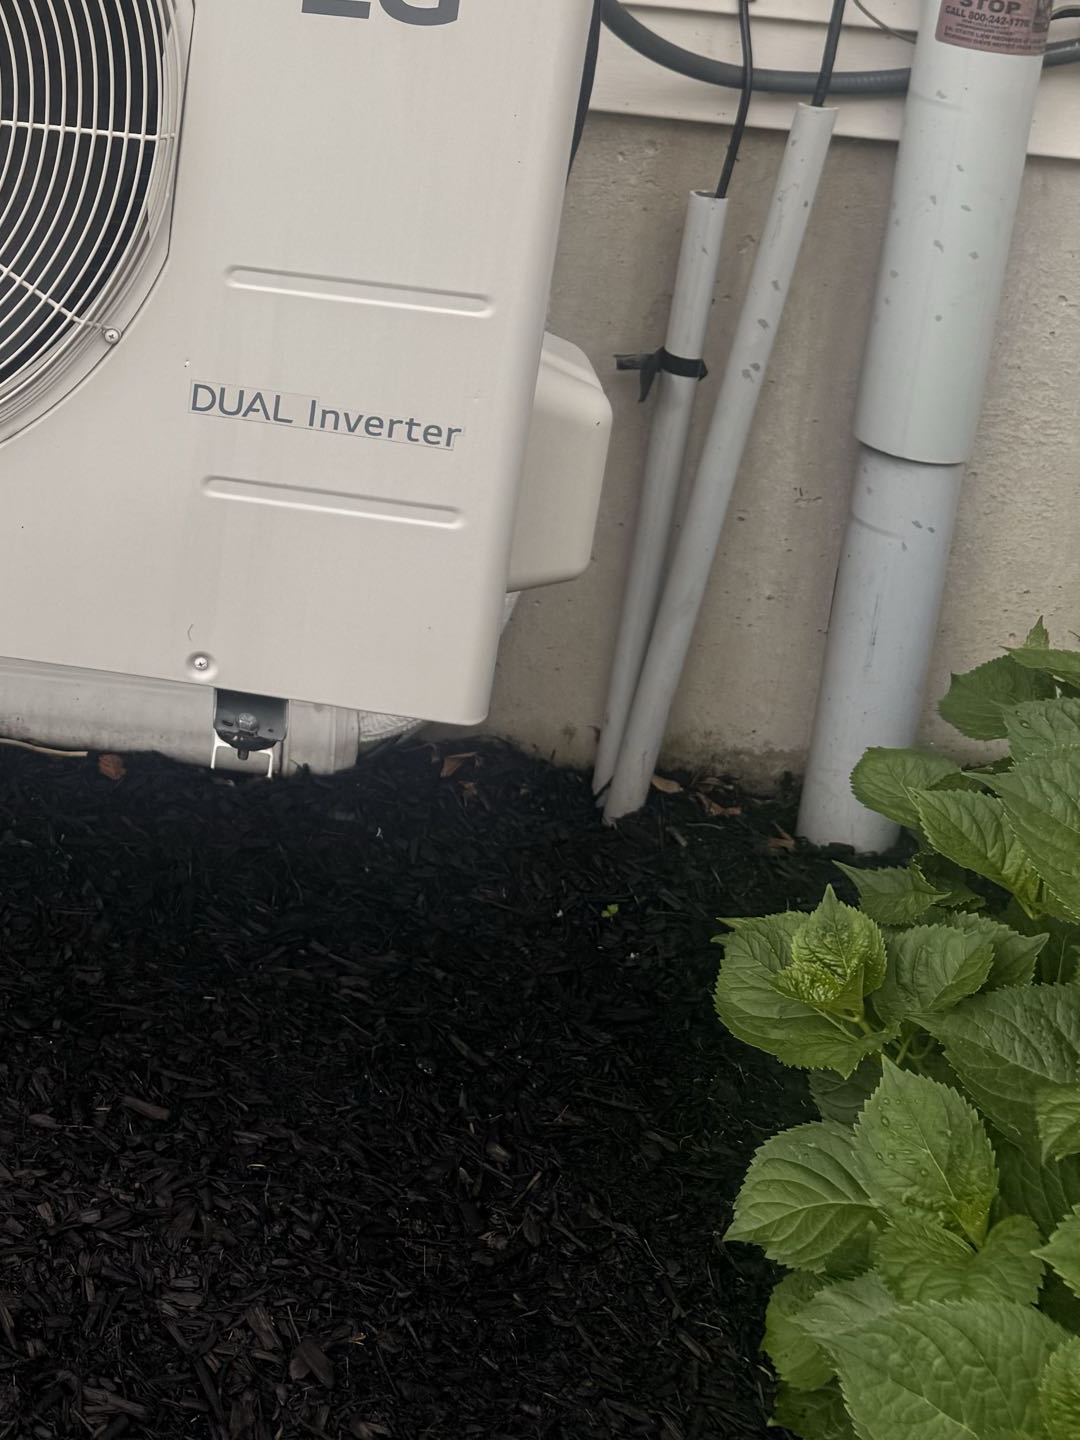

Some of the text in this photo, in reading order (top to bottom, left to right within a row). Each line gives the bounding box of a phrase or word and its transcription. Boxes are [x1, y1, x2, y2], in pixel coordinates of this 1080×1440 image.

[945, 5, 967, 18] CALL
[191, 383, 463, 448] DUAL Inverter
